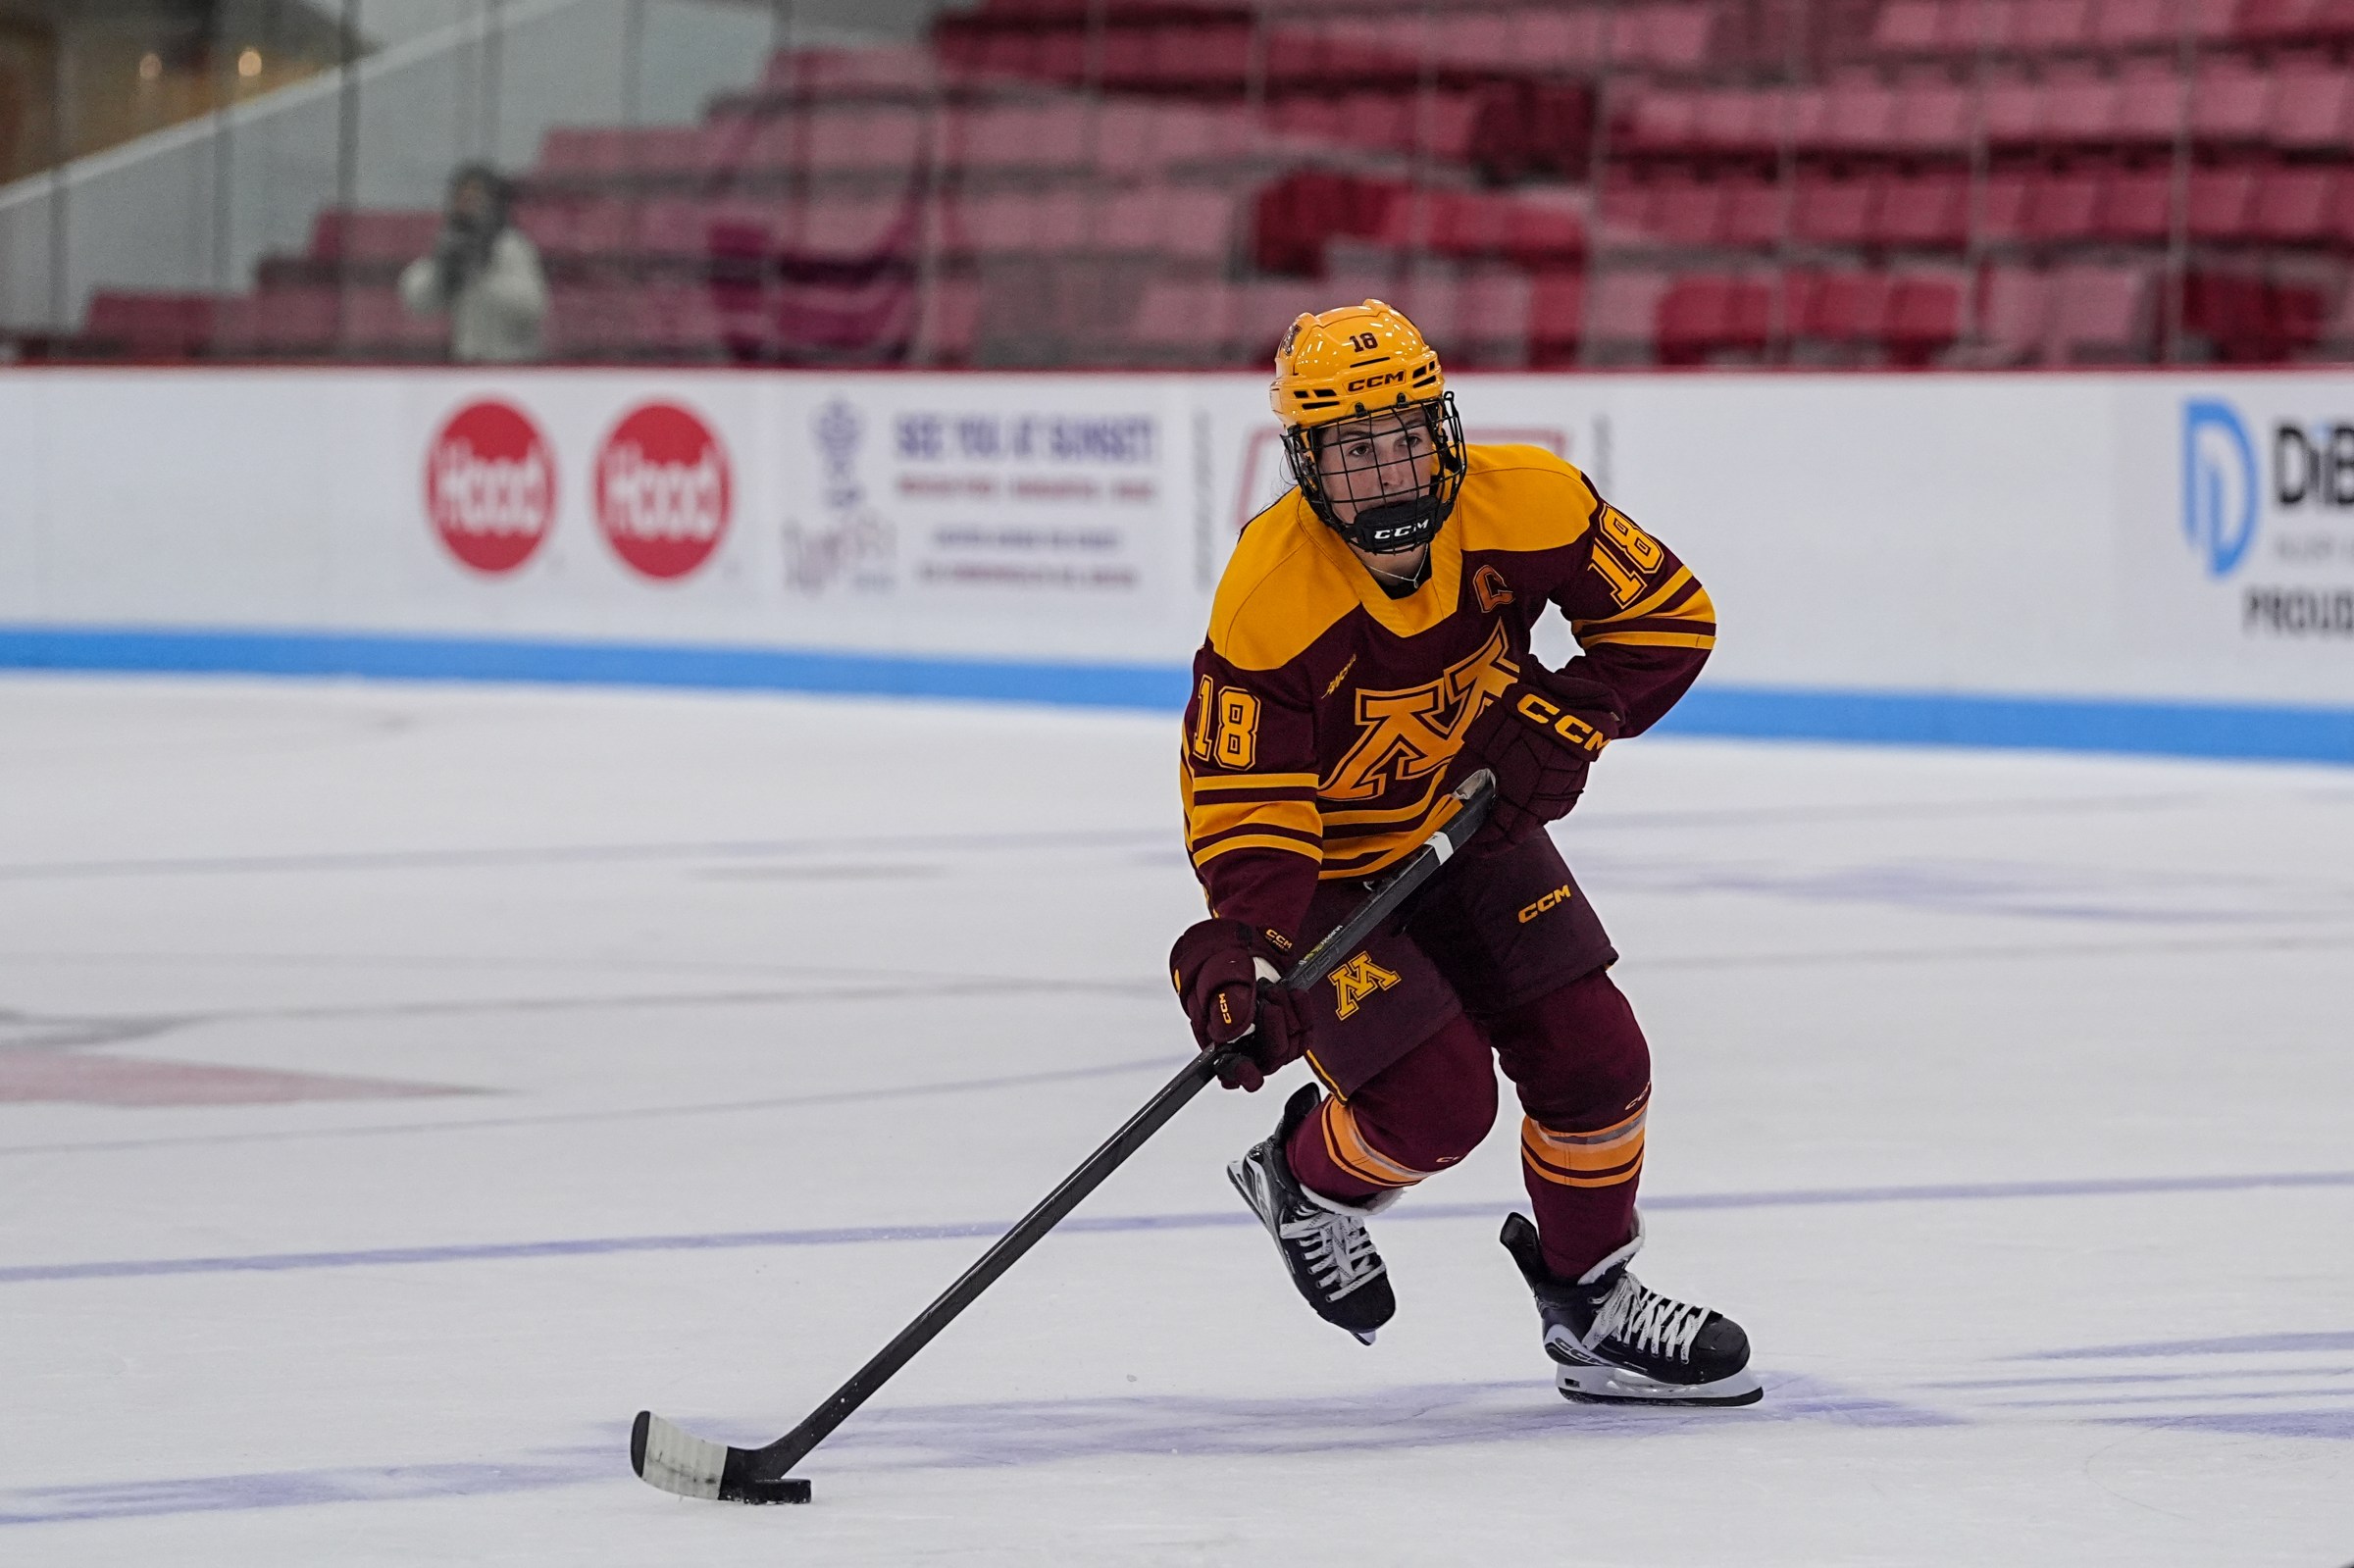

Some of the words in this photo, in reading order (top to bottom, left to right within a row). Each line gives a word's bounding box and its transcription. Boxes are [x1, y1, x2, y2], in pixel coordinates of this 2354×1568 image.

[1350, 331, 1379, 353] 18
[1347, 370, 1406, 393] CCM
[439, 439, 545, 536] Hood
[604, 440, 723, 542] Hood
[1373, 518, 1430, 541] CCM
[1587, 502, 1665, 610] 18
[1472, 564, 1516, 614] C
[1193, 674, 1261, 772] 18
[1516, 693, 1612, 757] CCM
[1517, 884, 1572, 924] CCM
[1265, 928, 1294, 950] CCM
[1218, 992, 1233, 1025] CCM
[1327, 949, 1403, 1022] M
